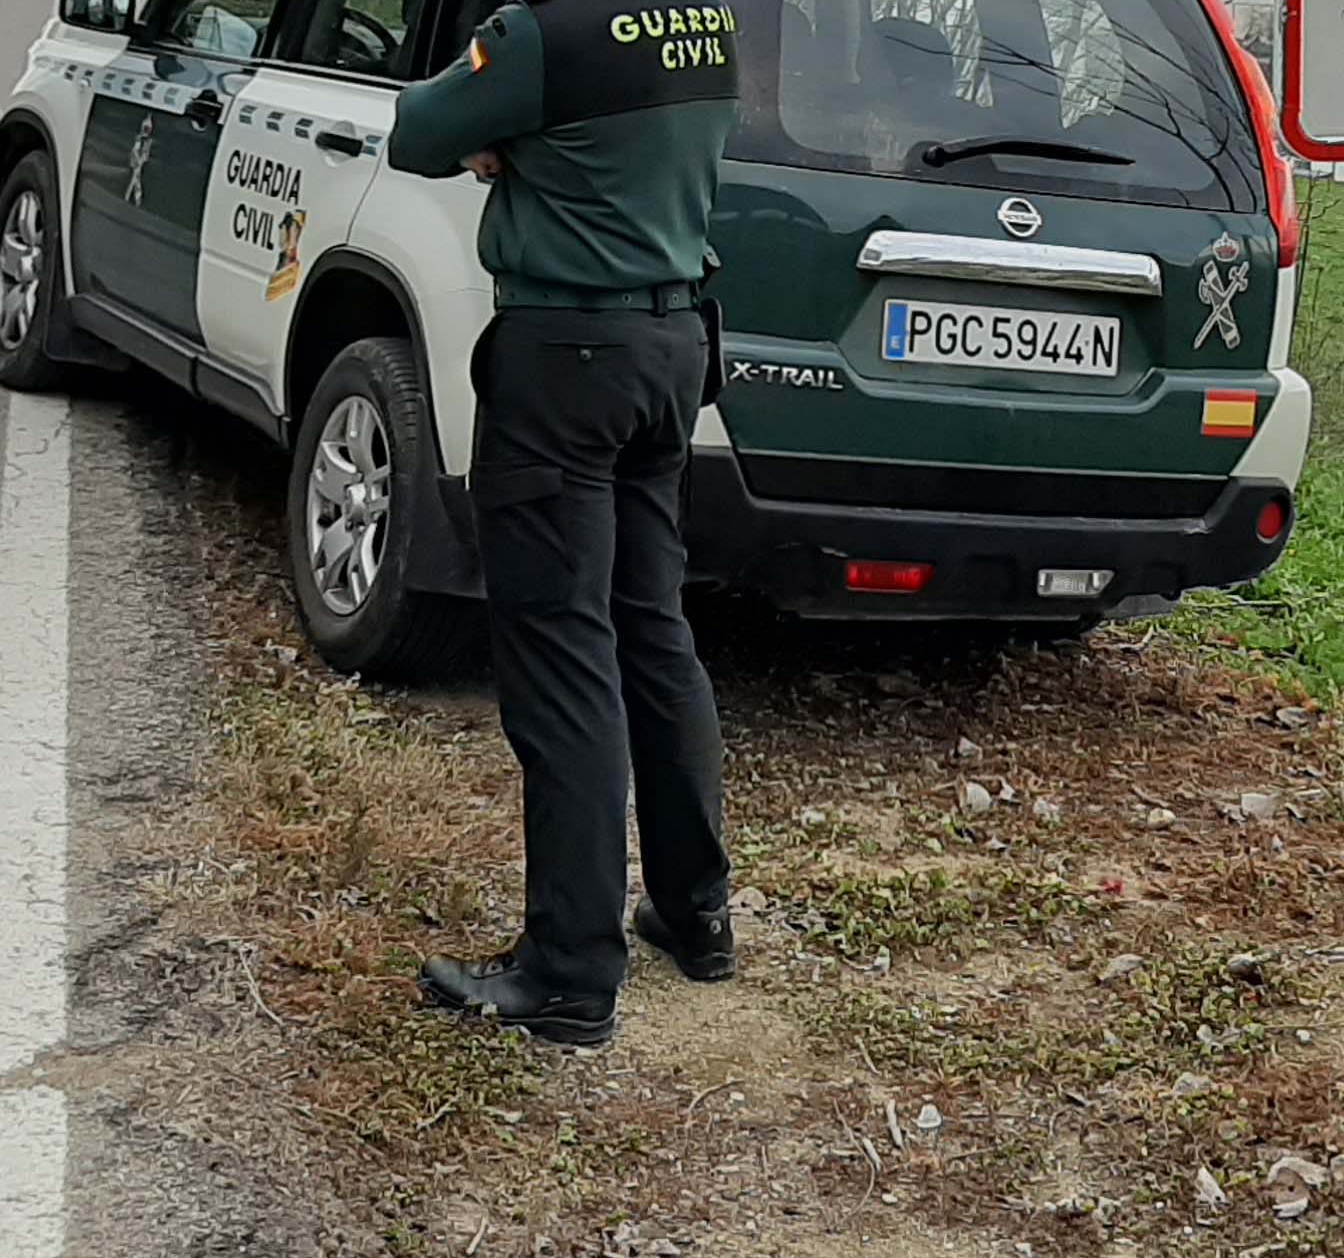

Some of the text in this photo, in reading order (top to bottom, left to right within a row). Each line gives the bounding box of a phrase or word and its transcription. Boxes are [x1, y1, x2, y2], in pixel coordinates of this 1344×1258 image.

[661, 36, 726, 70] CIVIL
[226, 149, 301, 205] GUARDIA
[233, 203, 274, 251] CIVIL
[729, 361, 844, 390] X-TRAIL
